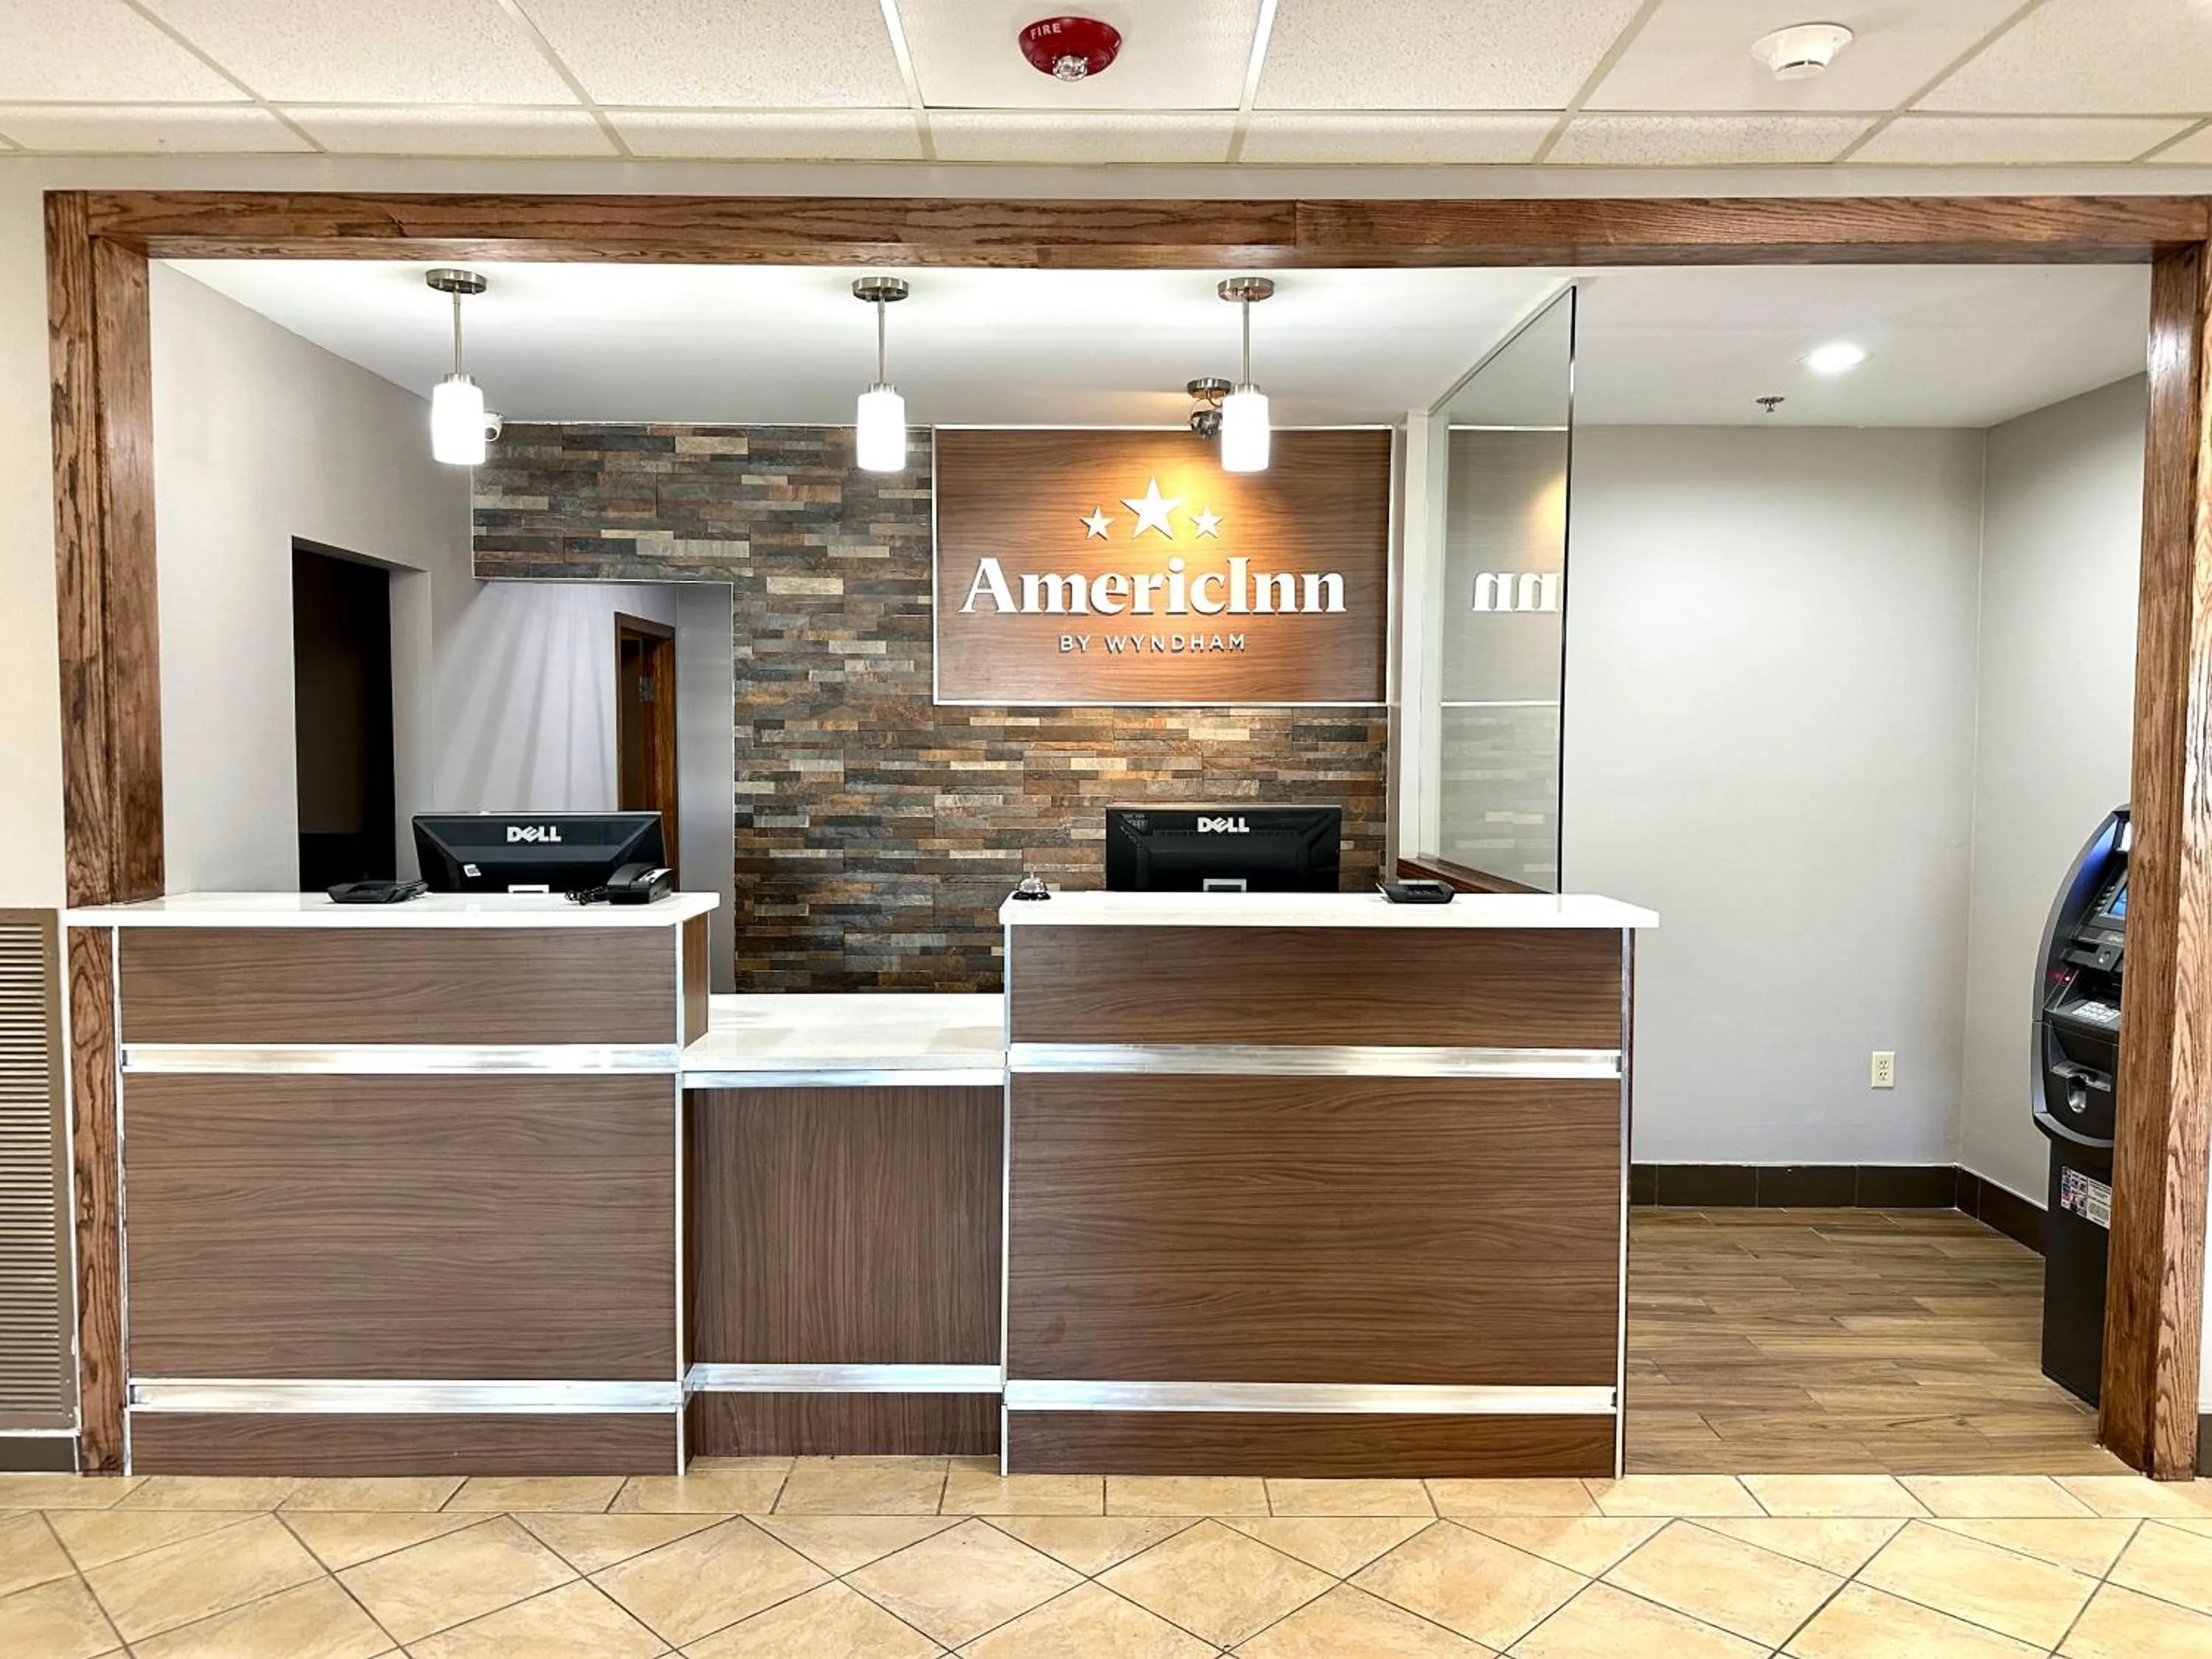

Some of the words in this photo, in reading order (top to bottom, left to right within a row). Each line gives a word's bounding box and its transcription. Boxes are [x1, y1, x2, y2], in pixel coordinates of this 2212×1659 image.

[1030, 23, 1062, 40] FIRE
[958, 556, 1347, 615] AmericInn
[1059, 634, 1091, 653] BY
[1105, 633, 1245, 653] WYNDHAM
[507, 825, 562, 843] DELL
[1197, 816, 1251, 834] DELL
